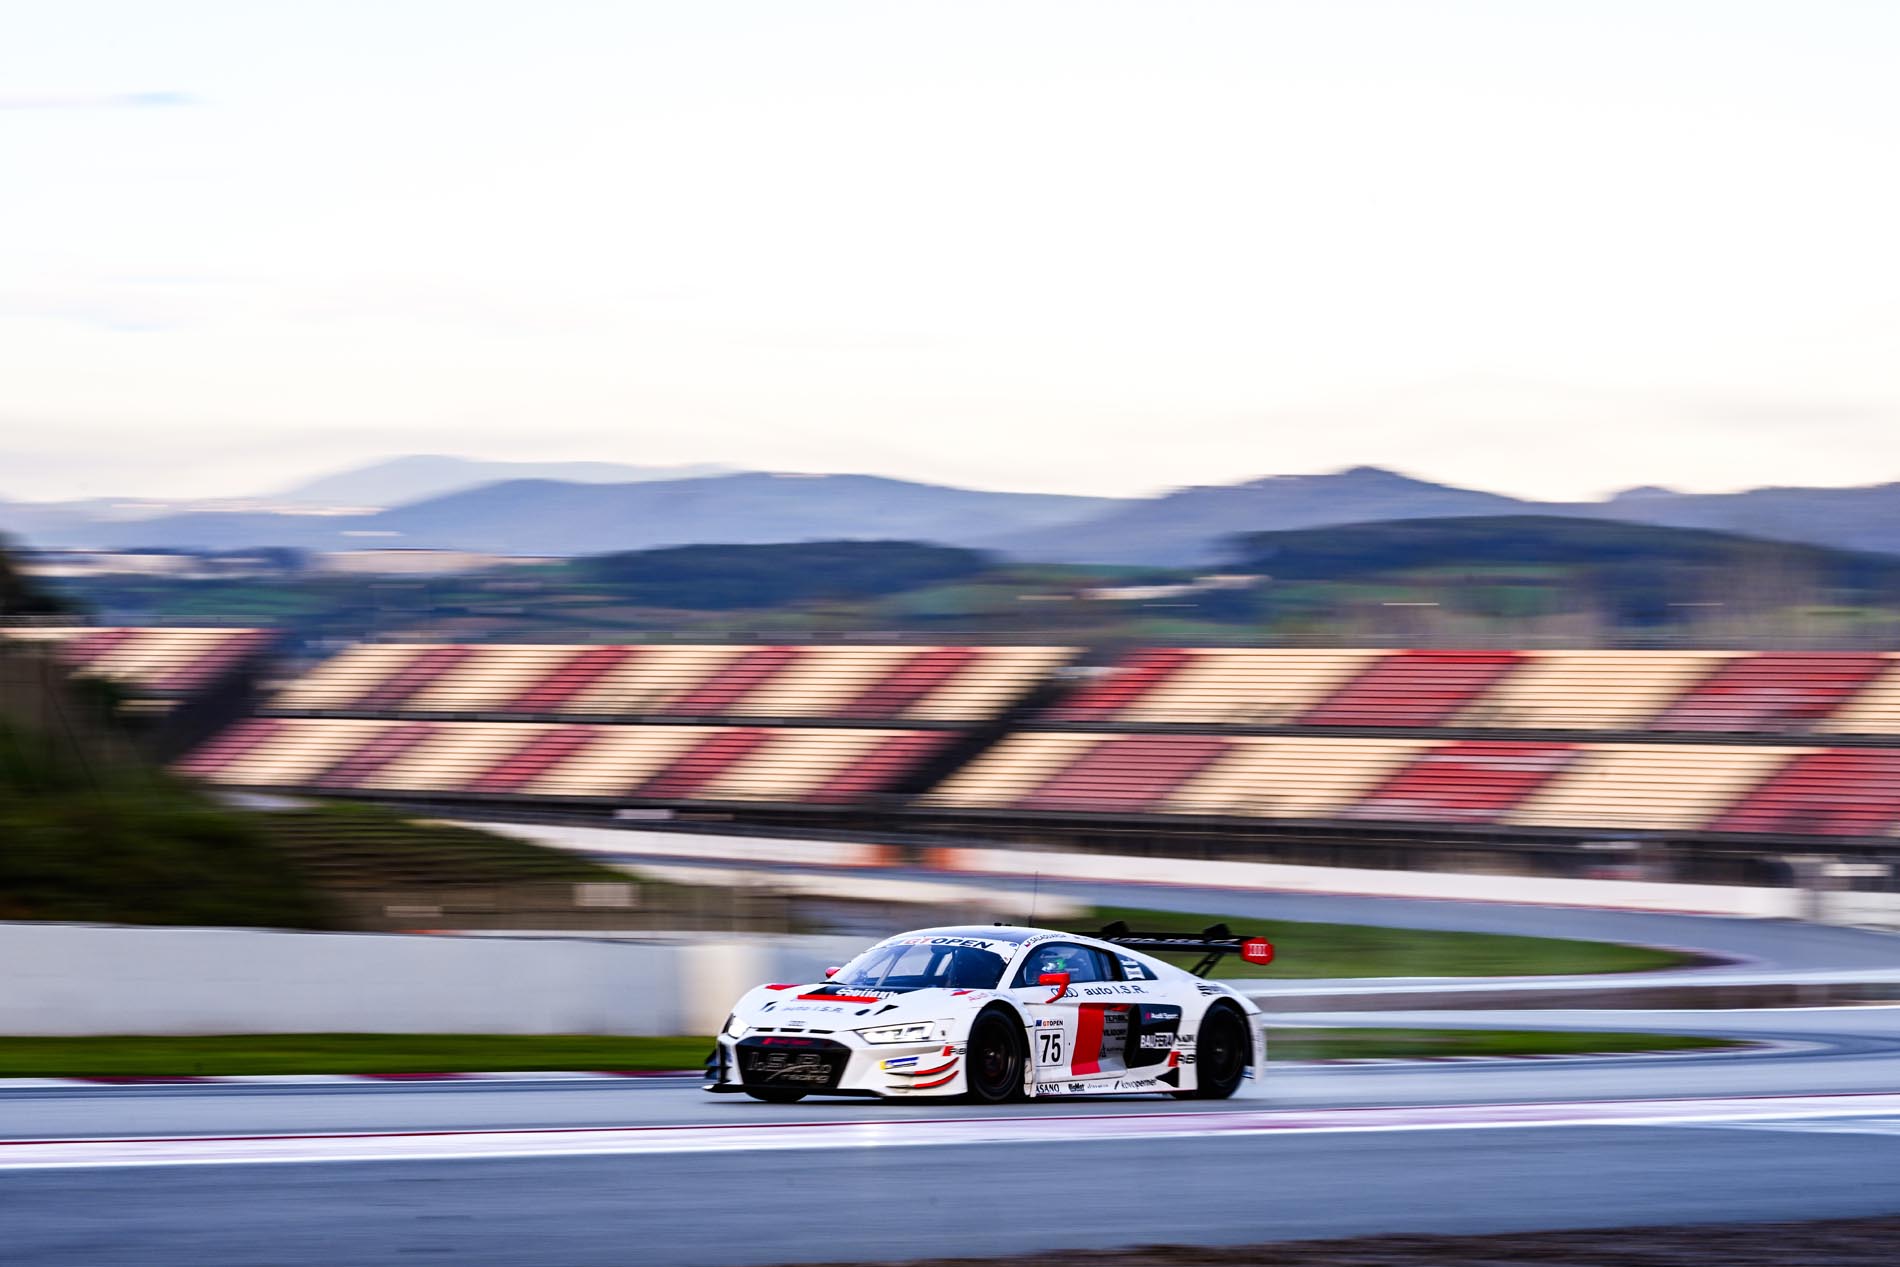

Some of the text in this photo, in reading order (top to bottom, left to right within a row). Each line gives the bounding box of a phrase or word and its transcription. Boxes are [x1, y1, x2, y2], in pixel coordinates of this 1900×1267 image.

[904, 938, 994, 949] GTOPEN
[1084, 987, 1112, 996] auto
[1040, 1034, 1060, 1063] 75
